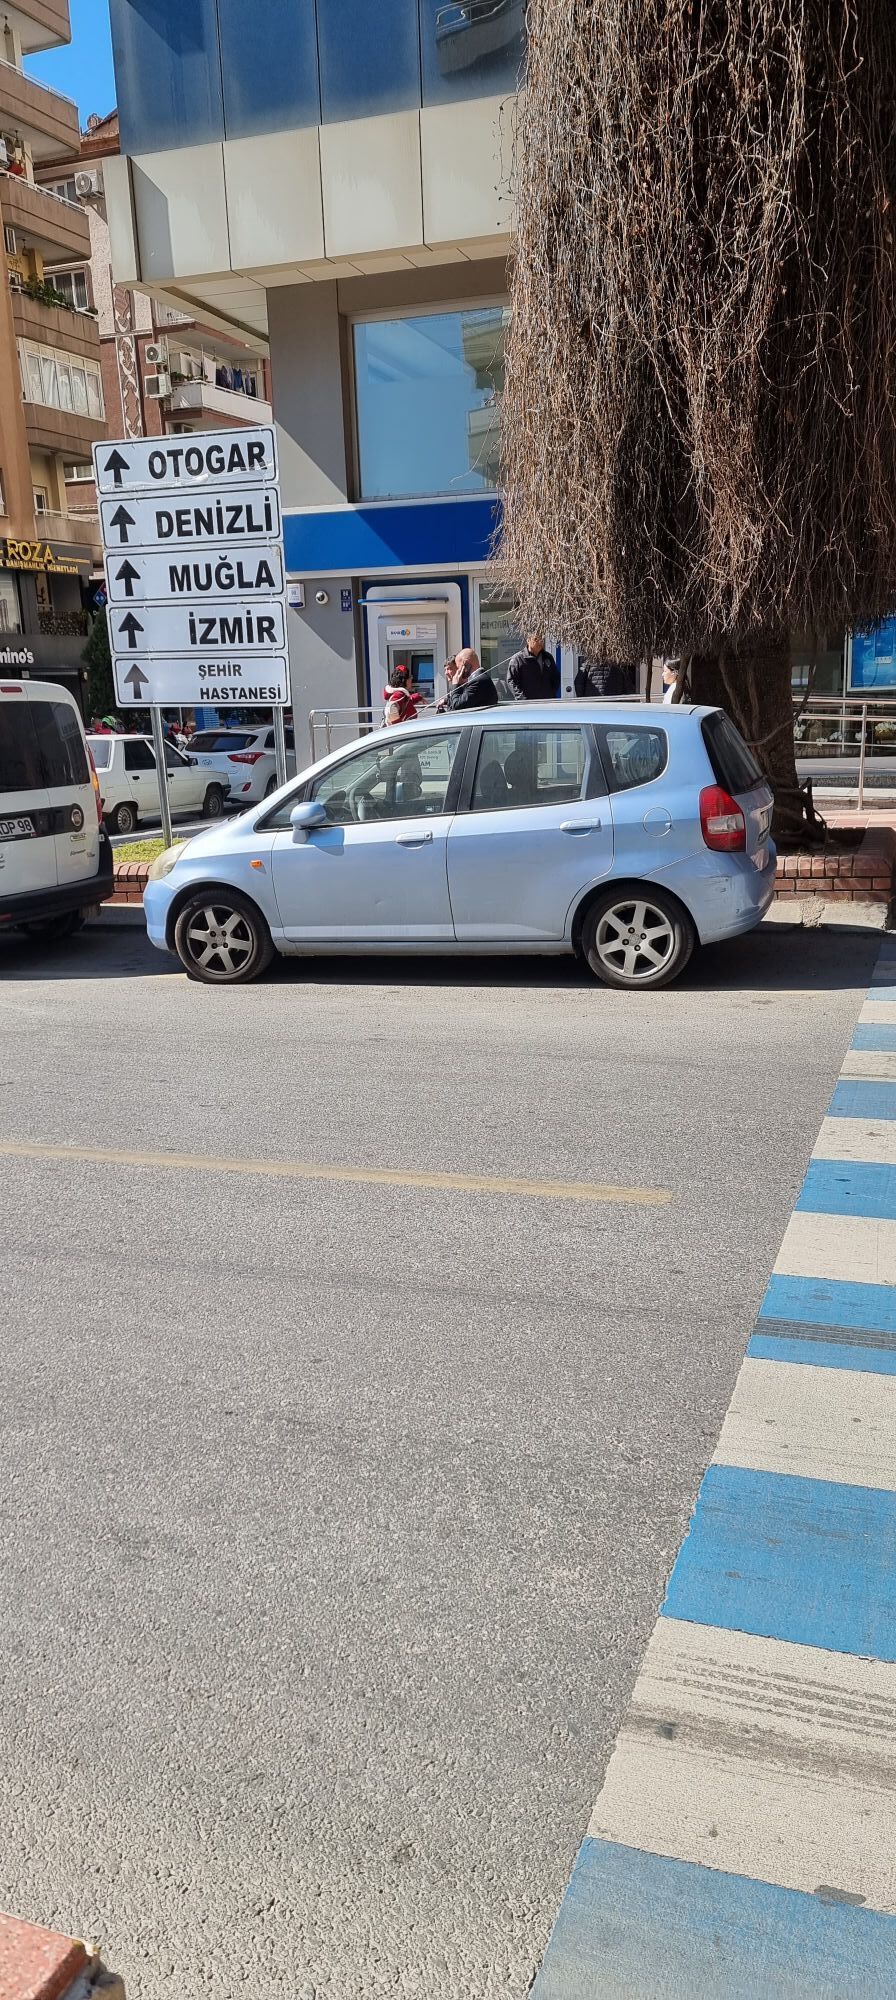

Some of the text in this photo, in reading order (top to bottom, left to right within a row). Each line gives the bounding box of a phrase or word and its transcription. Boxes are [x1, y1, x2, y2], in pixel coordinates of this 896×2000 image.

[149, 440, 268, 480] OTOGAR
[156, 495, 273, 539] DENİZLİ
[6, 539, 55, 564] ROZA
[169, 555, 276, 593] MUĞLA
[188, 610, 278, 645] İZMİR
[198, 660, 242, 680] ŞEHİR
[200, 683, 282, 701] HASTANESİ
[17, 819, 32, 832] 98
